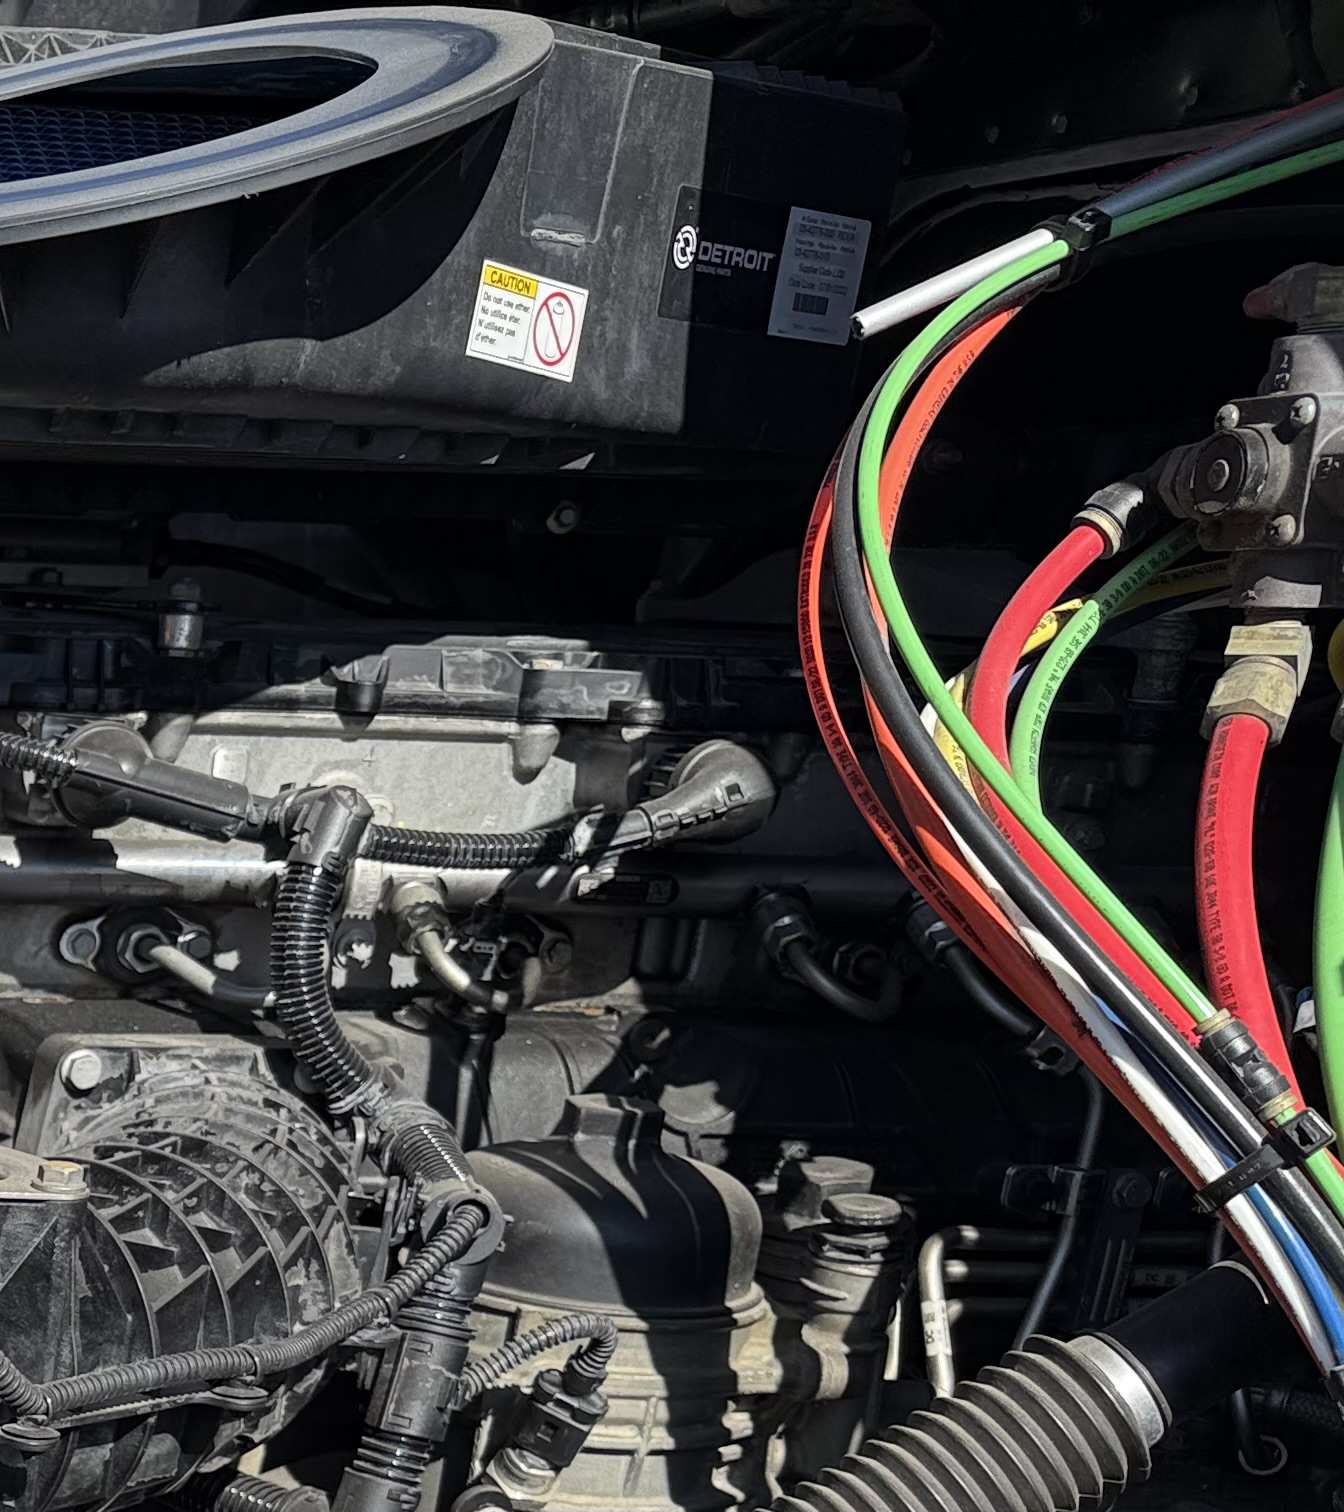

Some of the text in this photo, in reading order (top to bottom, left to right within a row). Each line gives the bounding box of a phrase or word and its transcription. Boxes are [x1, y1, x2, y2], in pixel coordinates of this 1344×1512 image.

[698, 241, 776, 272] DETROIT
[490, 271, 531, 294] CAUTION
[1207, 912, 1220, 932] TYPE
